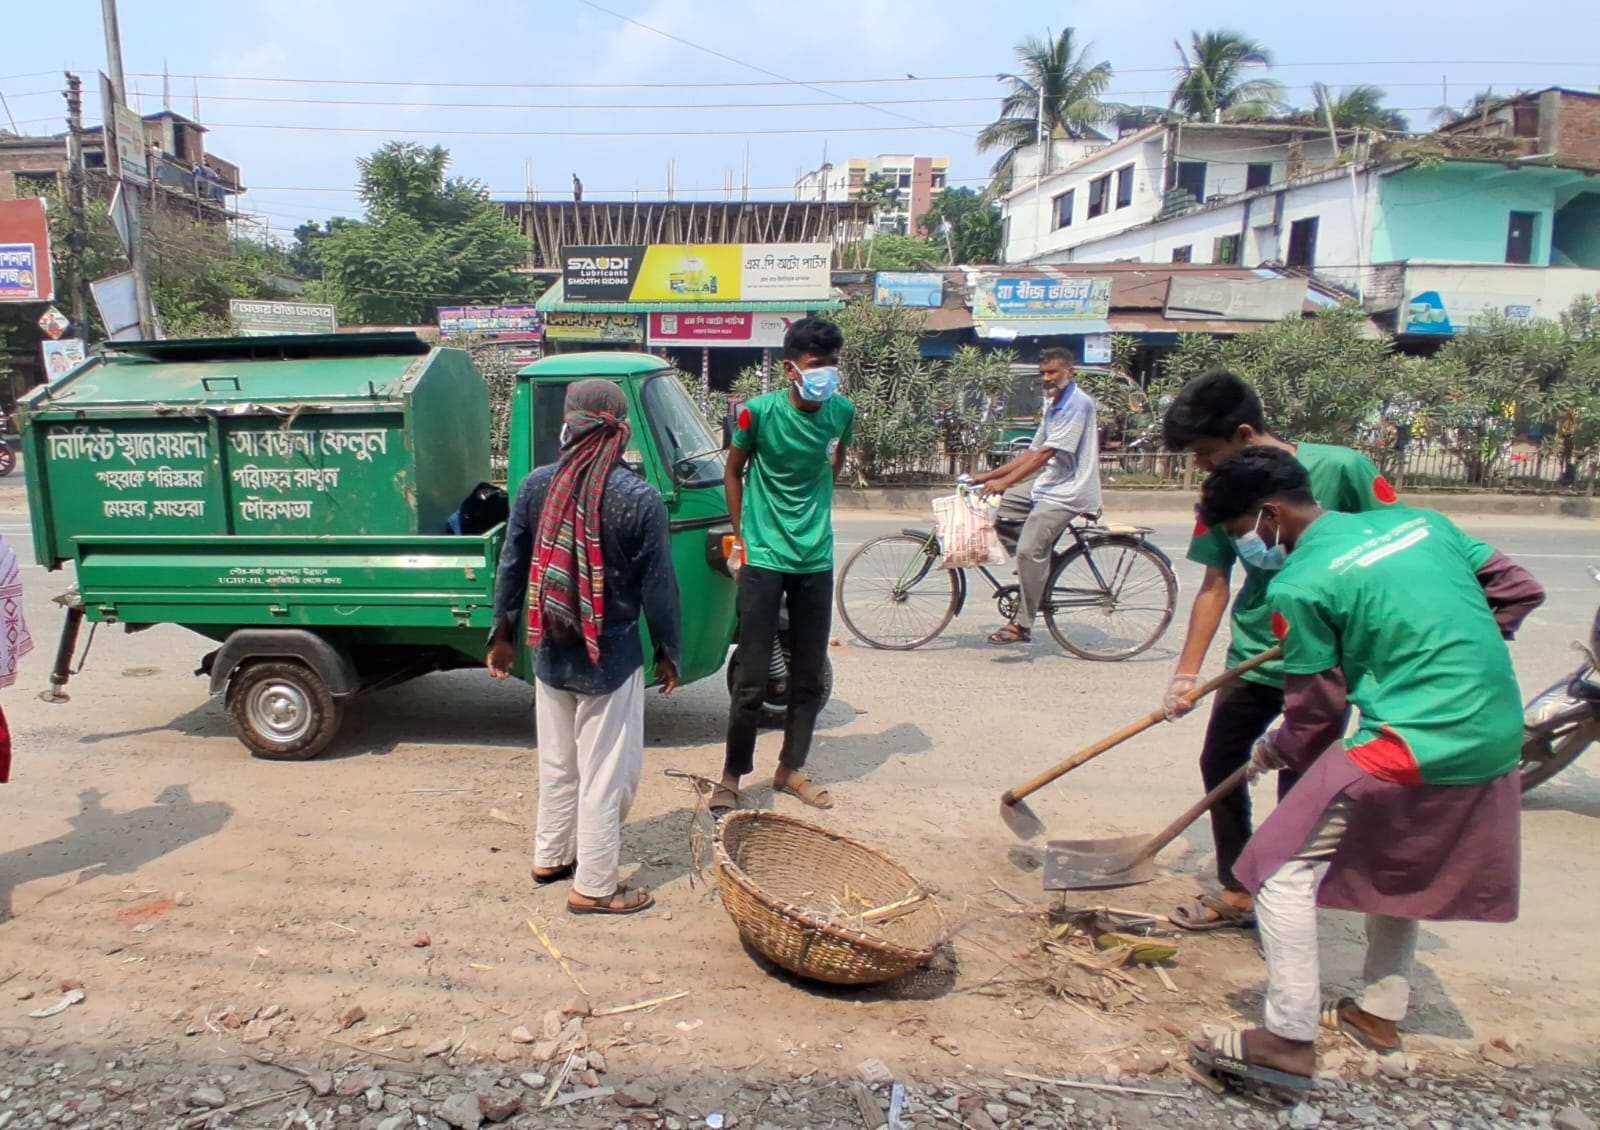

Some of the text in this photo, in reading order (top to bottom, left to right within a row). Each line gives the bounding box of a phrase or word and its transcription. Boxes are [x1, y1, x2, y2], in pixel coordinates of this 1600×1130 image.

[568, 256, 629, 270] SAUDI
[776, 254, 800, 270] অটো
[802, 254, 827, 269] পার্টস
[567, 278, 600, 286] SMOOTH
[997, 285, 1013, 299] মা
[1016, 280, 1046, 299] বীজ
[47, 425, 115, 462] নির্দিষ্ট
[116, 432, 156, 466] স্থানে
[156, 432, 207, 459] ময়লা
[319, 428, 388, 463] ফেলুন
[96, 470, 146, 490] শহরকে
[294, 468, 340, 492] রাখুন
[153, 500, 206, 518] মাগুরা
[239, 495, 313, 521] পৌরসভা
